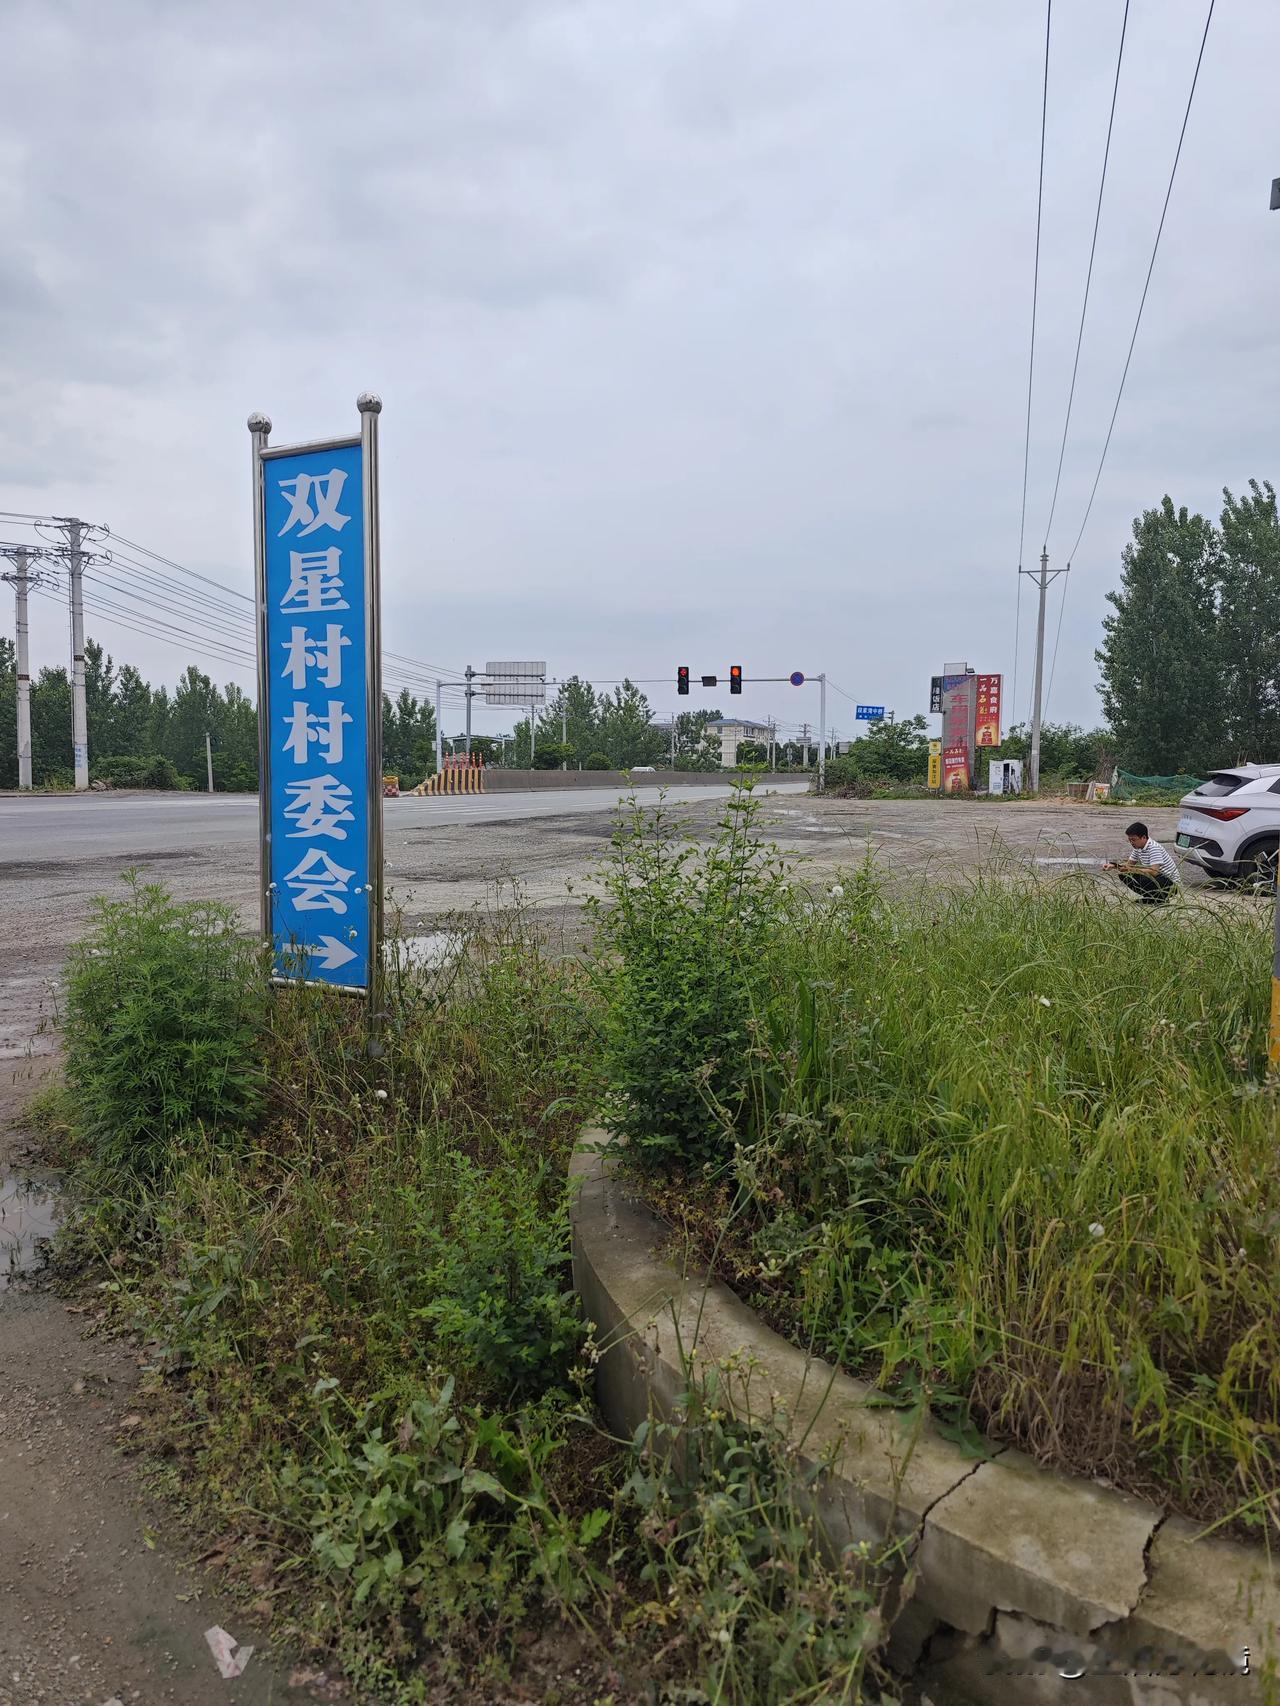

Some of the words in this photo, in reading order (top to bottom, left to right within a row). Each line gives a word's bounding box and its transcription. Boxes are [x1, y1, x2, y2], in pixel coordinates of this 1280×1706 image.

[277, 468, 356, 915] 双星村村委会
